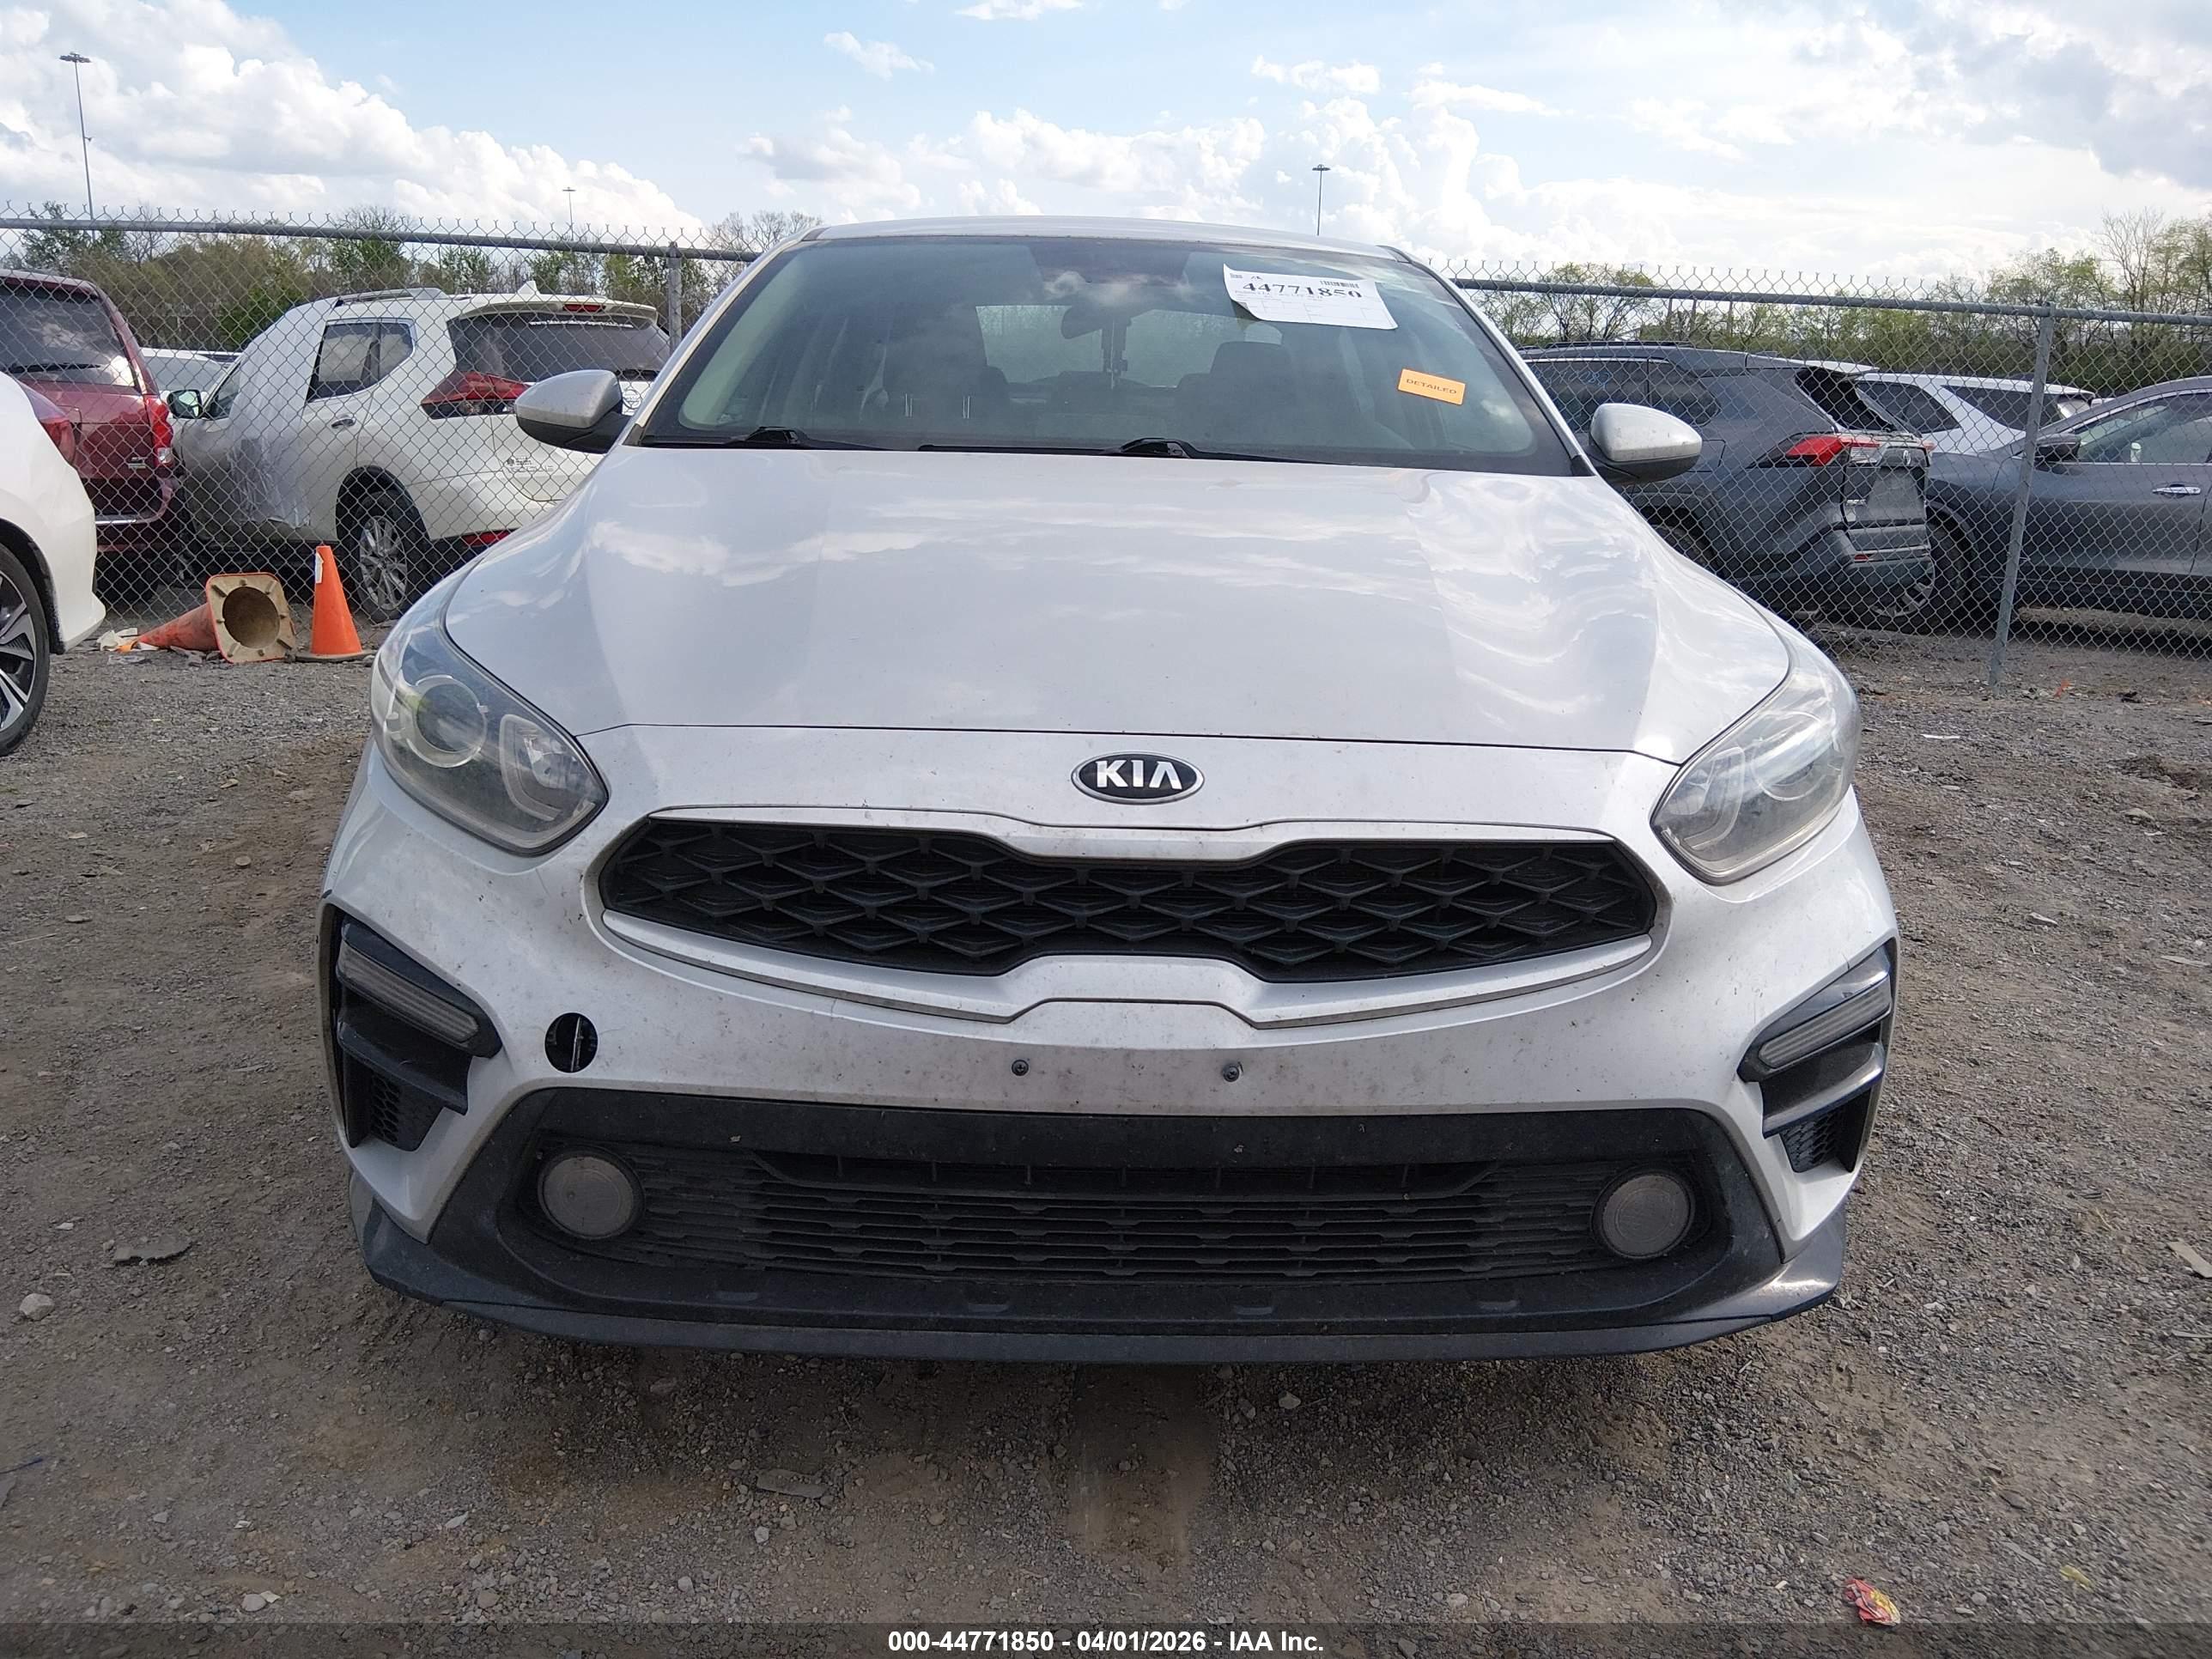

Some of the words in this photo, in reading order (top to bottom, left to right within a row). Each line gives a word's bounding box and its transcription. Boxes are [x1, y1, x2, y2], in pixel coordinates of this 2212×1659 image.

[1243, 283, 1362, 298] 44771850
[1406, 379, 1457, 394] DETAILED
[1095, 760, 1182, 790] KIA
